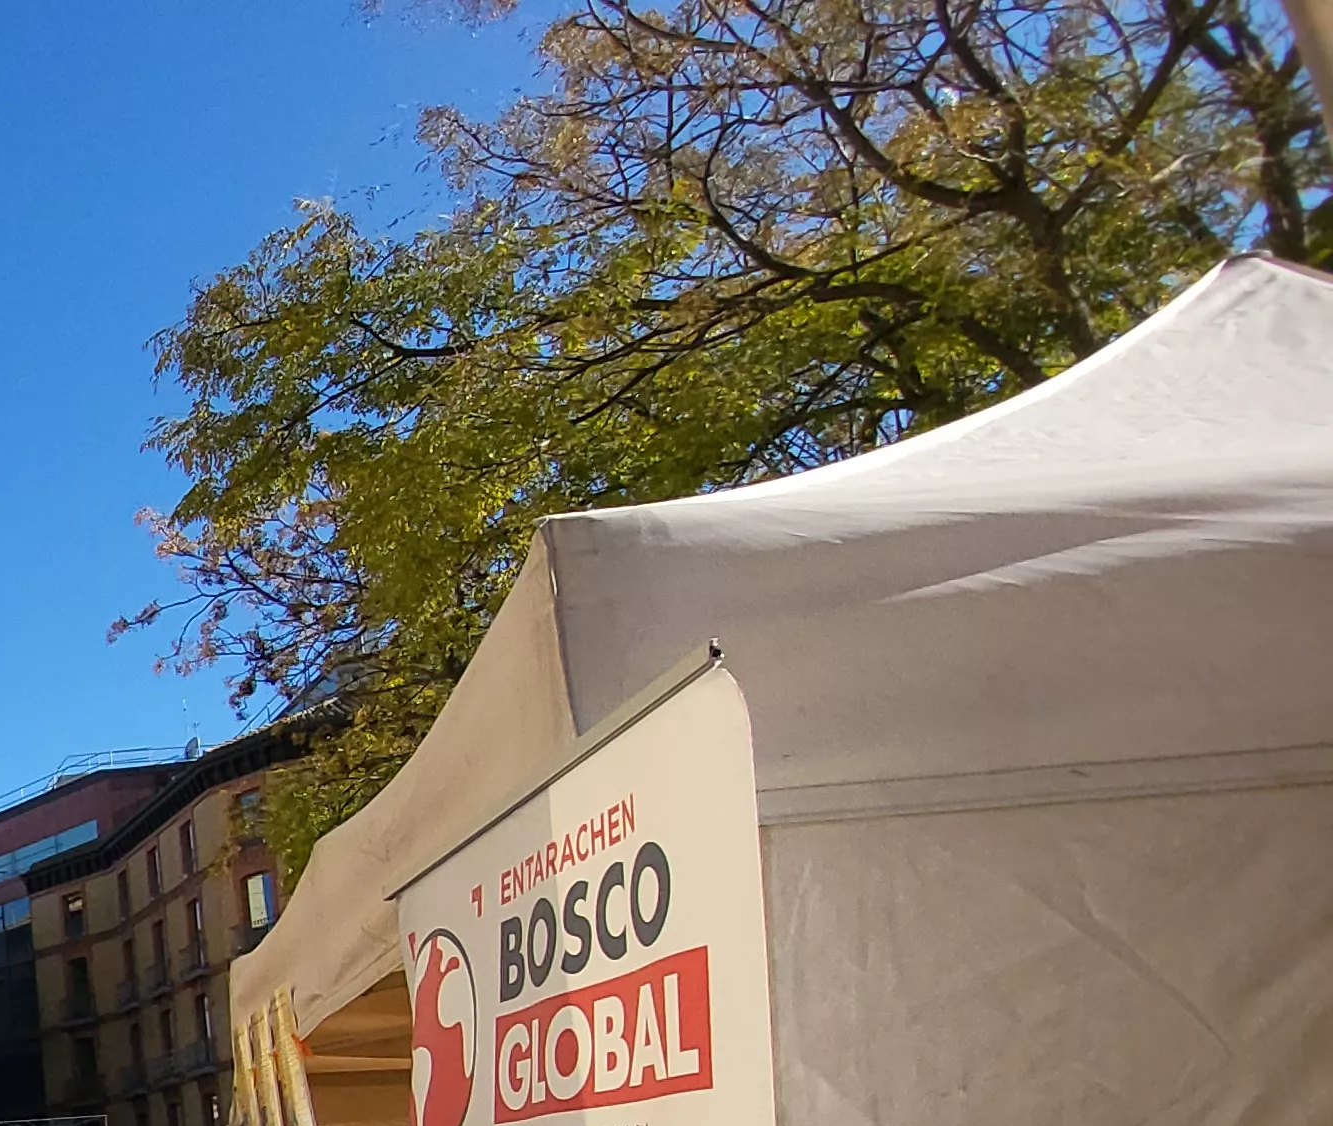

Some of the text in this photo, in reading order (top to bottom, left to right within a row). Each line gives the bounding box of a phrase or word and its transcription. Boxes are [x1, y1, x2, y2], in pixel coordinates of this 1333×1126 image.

[501, 794, 635, 905] ENTARACHEN
[500, 841, 671, 1003] BOSCO
[499, 973, 700, 1111] GLOBAL
